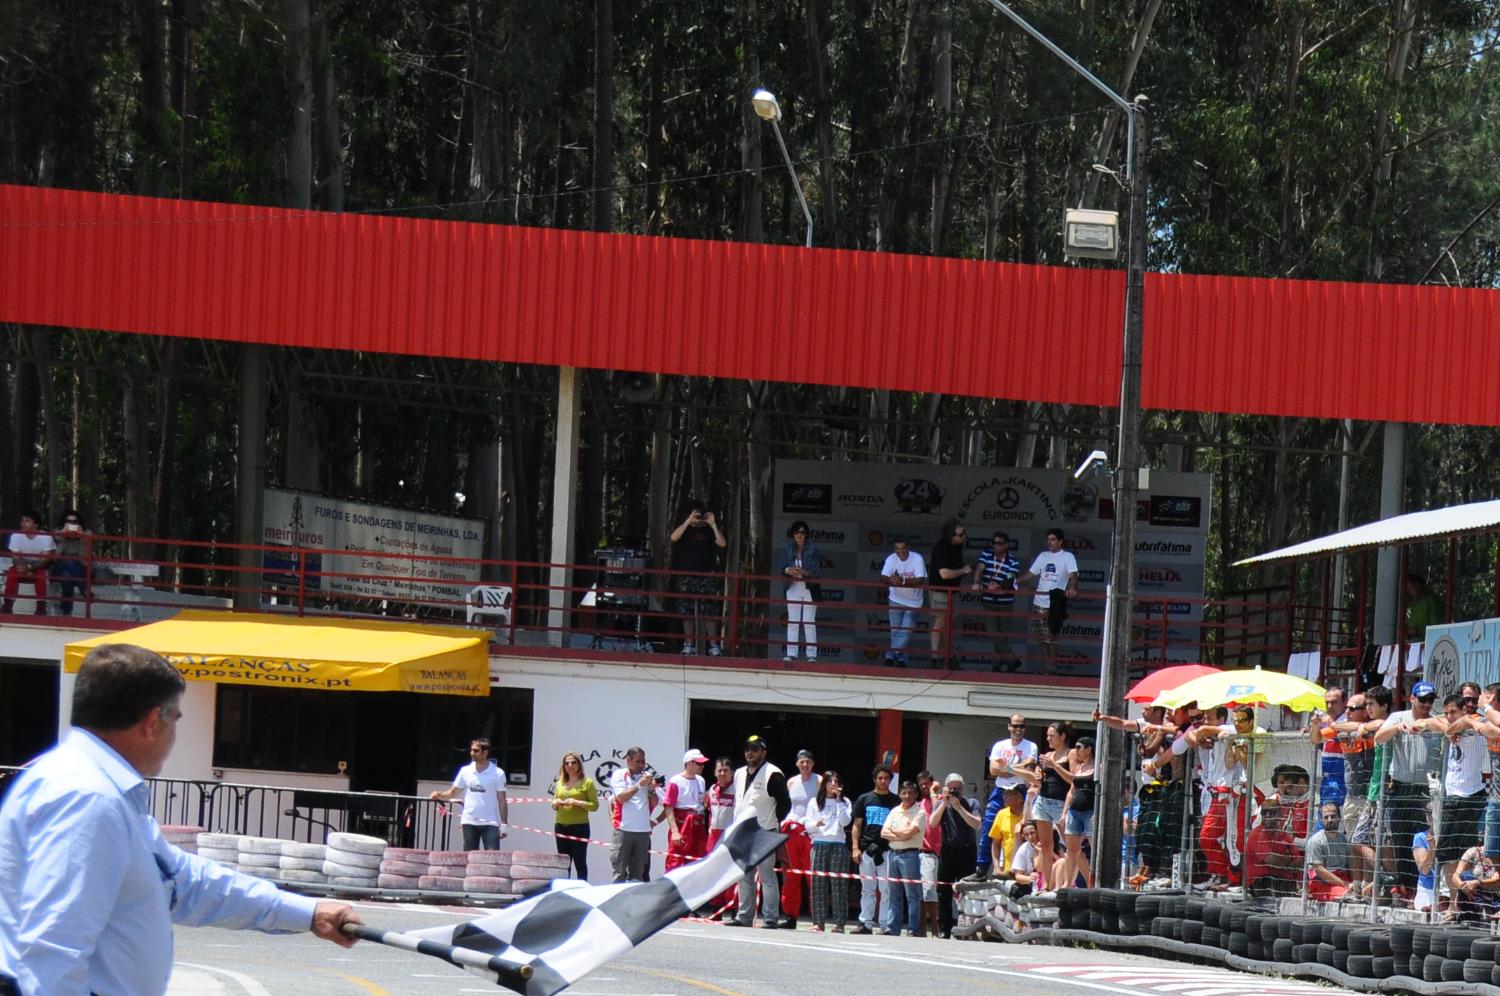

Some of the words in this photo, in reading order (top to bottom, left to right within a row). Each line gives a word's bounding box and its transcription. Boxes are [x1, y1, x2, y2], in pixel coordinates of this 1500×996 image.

[901, 481, 930, 498] 24
[838, 495, 884, 504] HONDA
[983, 511, 1036, 521] EUROINDY
[1138, 570, 1182, 582] HELIX
